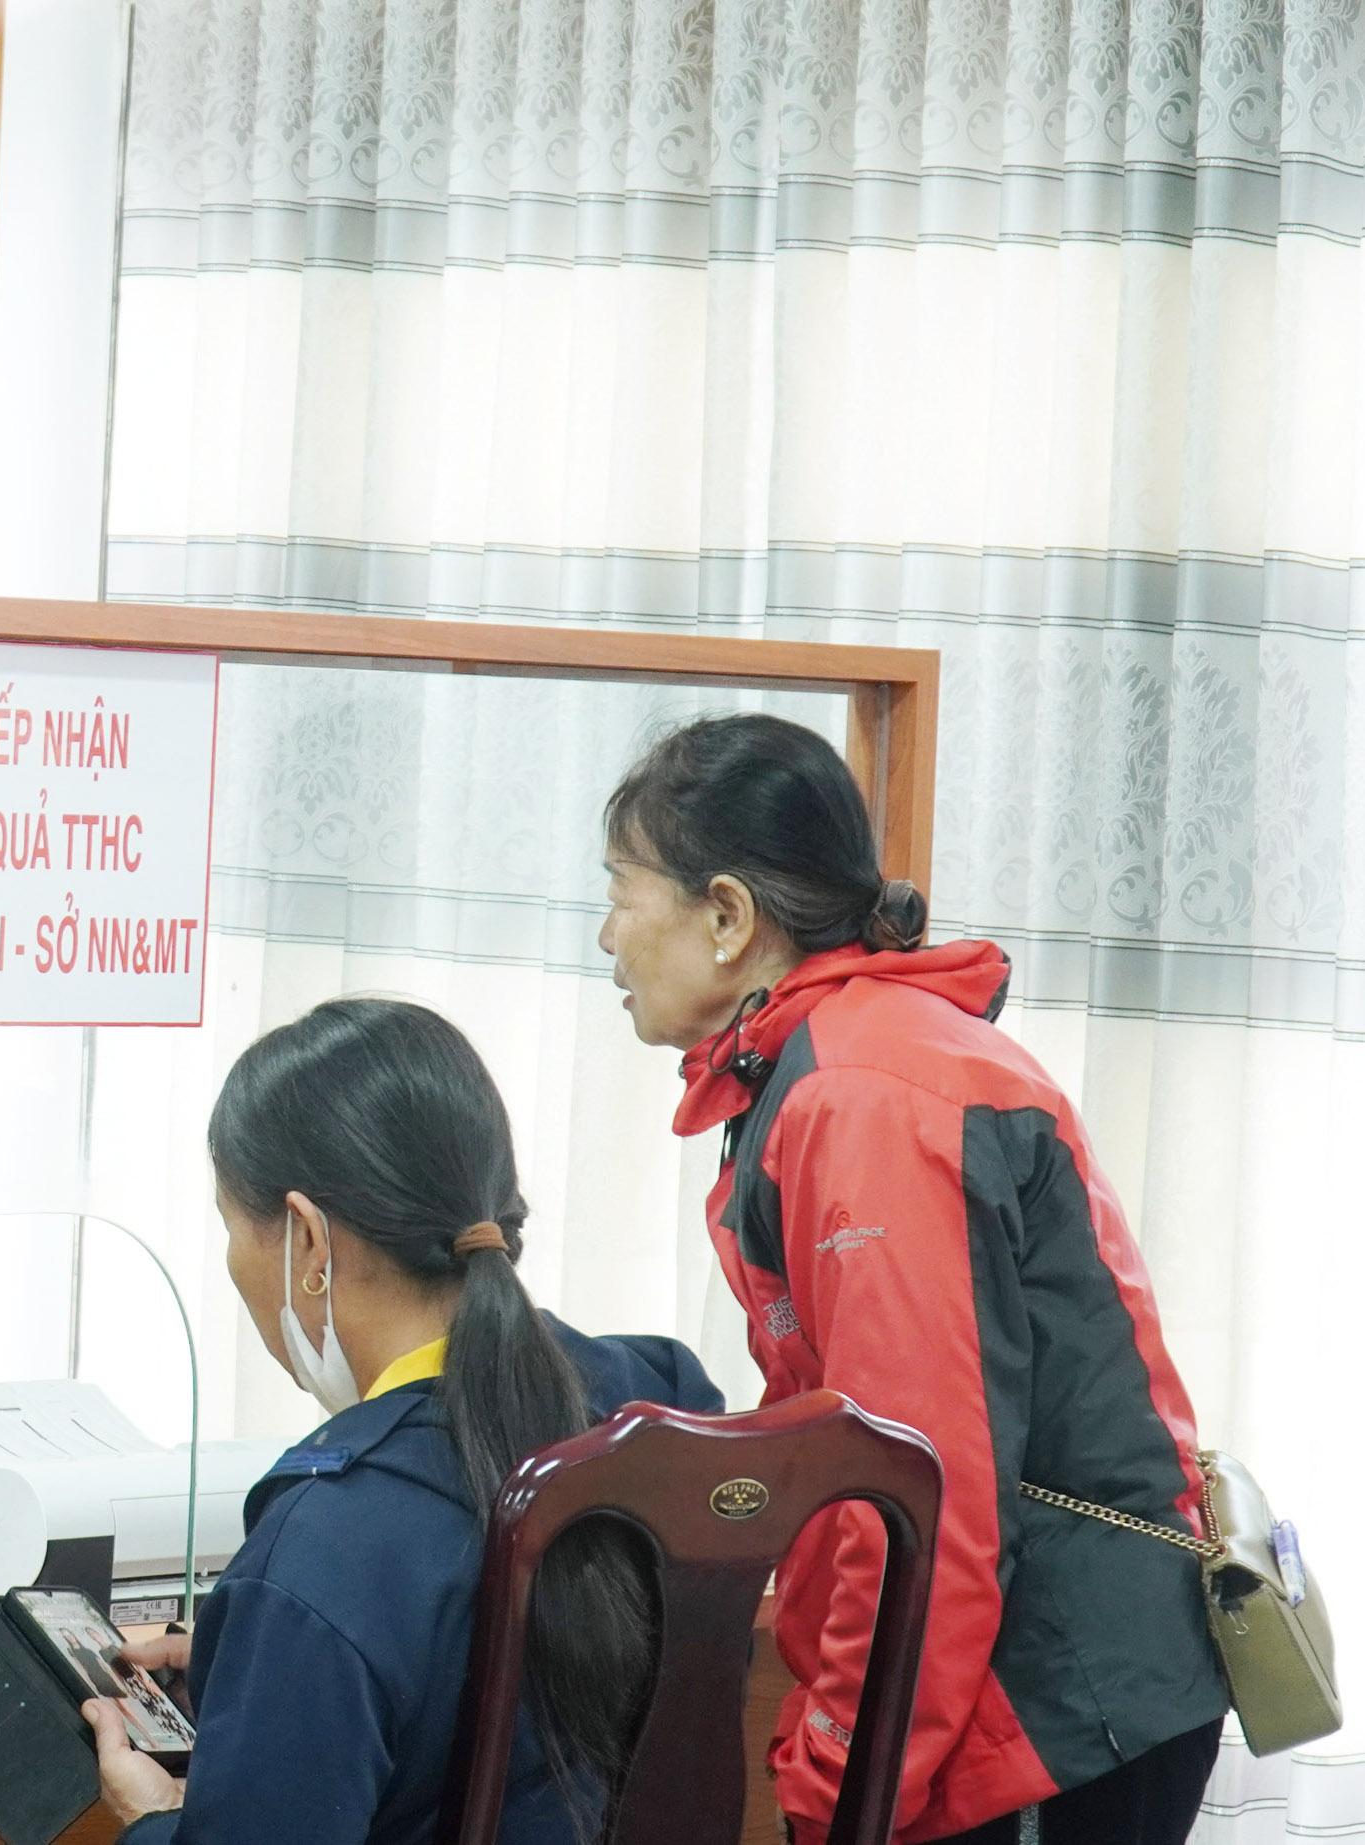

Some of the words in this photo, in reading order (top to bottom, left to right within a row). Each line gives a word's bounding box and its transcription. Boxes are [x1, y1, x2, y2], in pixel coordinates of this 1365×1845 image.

[43, 695, 130, 782] NHẬN
[63, 813, 143, 873] TTHC
[35, 892, 80, 974] SỞ
[87, 916, 199, 975] NN&MT
